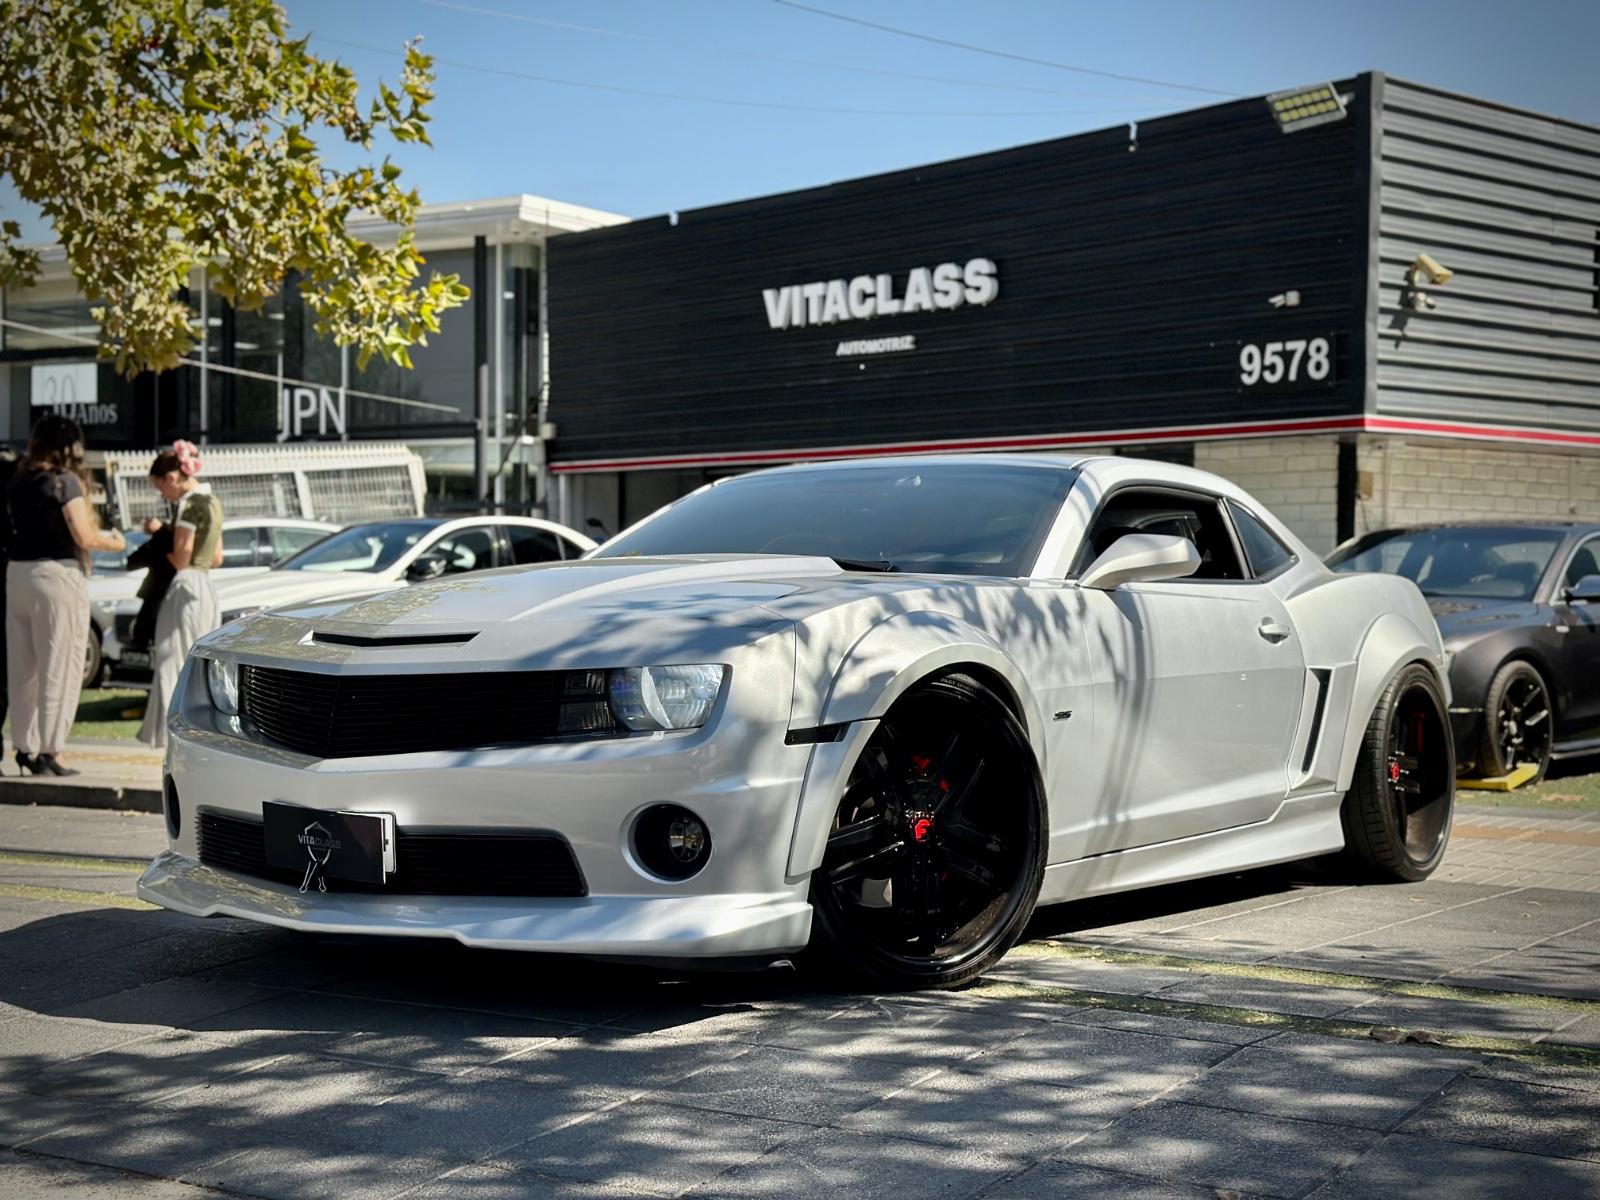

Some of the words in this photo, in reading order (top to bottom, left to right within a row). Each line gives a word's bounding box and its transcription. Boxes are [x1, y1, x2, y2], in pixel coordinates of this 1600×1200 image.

[762, 257, 999, 330] VITACLASS
[1240, 337, 1330, 386] 9578
[276, 387, 346, 443] JPN
